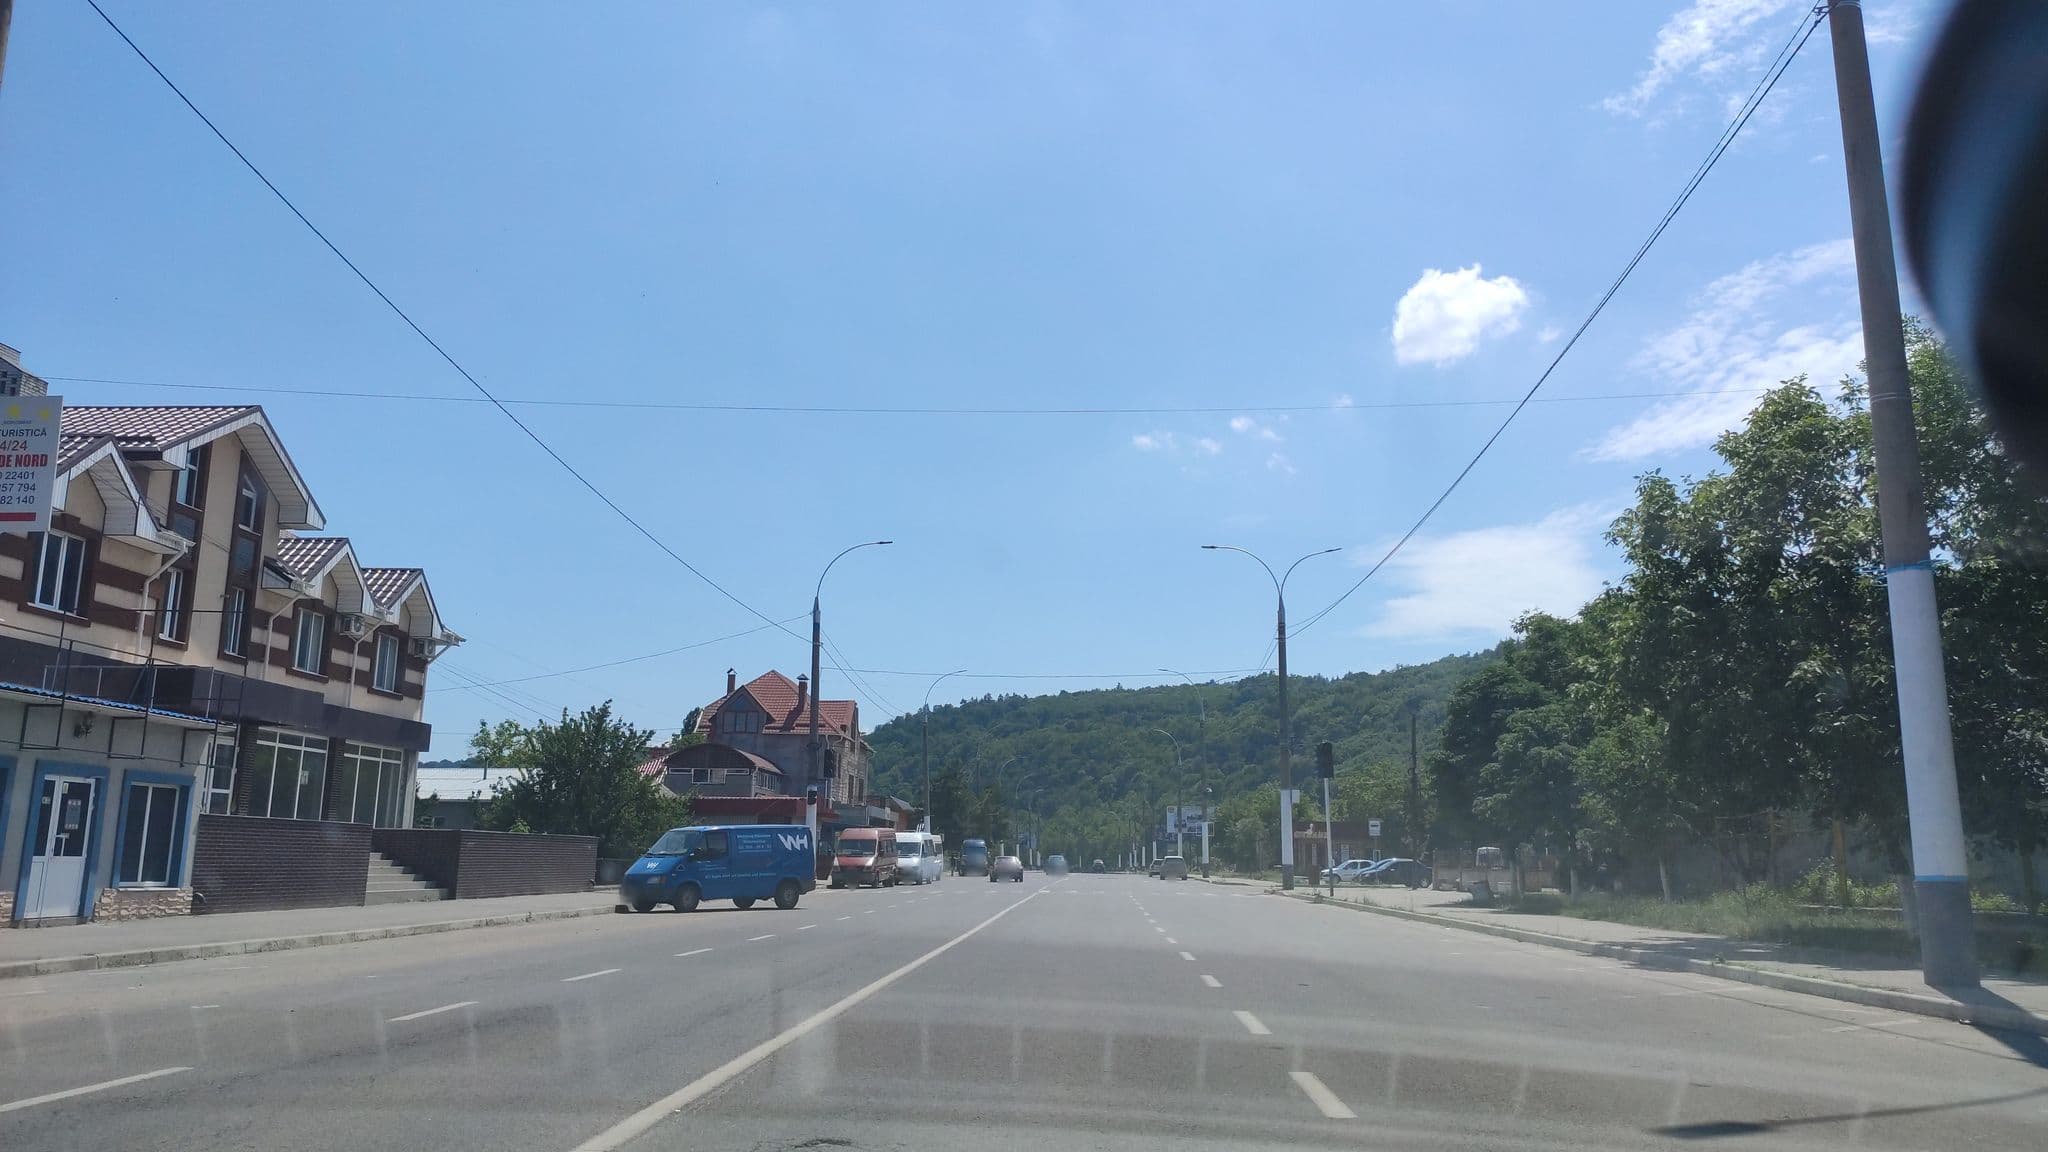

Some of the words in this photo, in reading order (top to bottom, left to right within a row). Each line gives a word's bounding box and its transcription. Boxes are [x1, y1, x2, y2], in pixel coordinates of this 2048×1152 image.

[0, 427, 47, 437] URISTICĂ
[15, 454, 48, 467] NORD
[5, 471, 35, 480] 22401
[0, 483, 15, 492] 57
[17, 483, 36, 492] 794
[16, 495, 35, 505] 140
